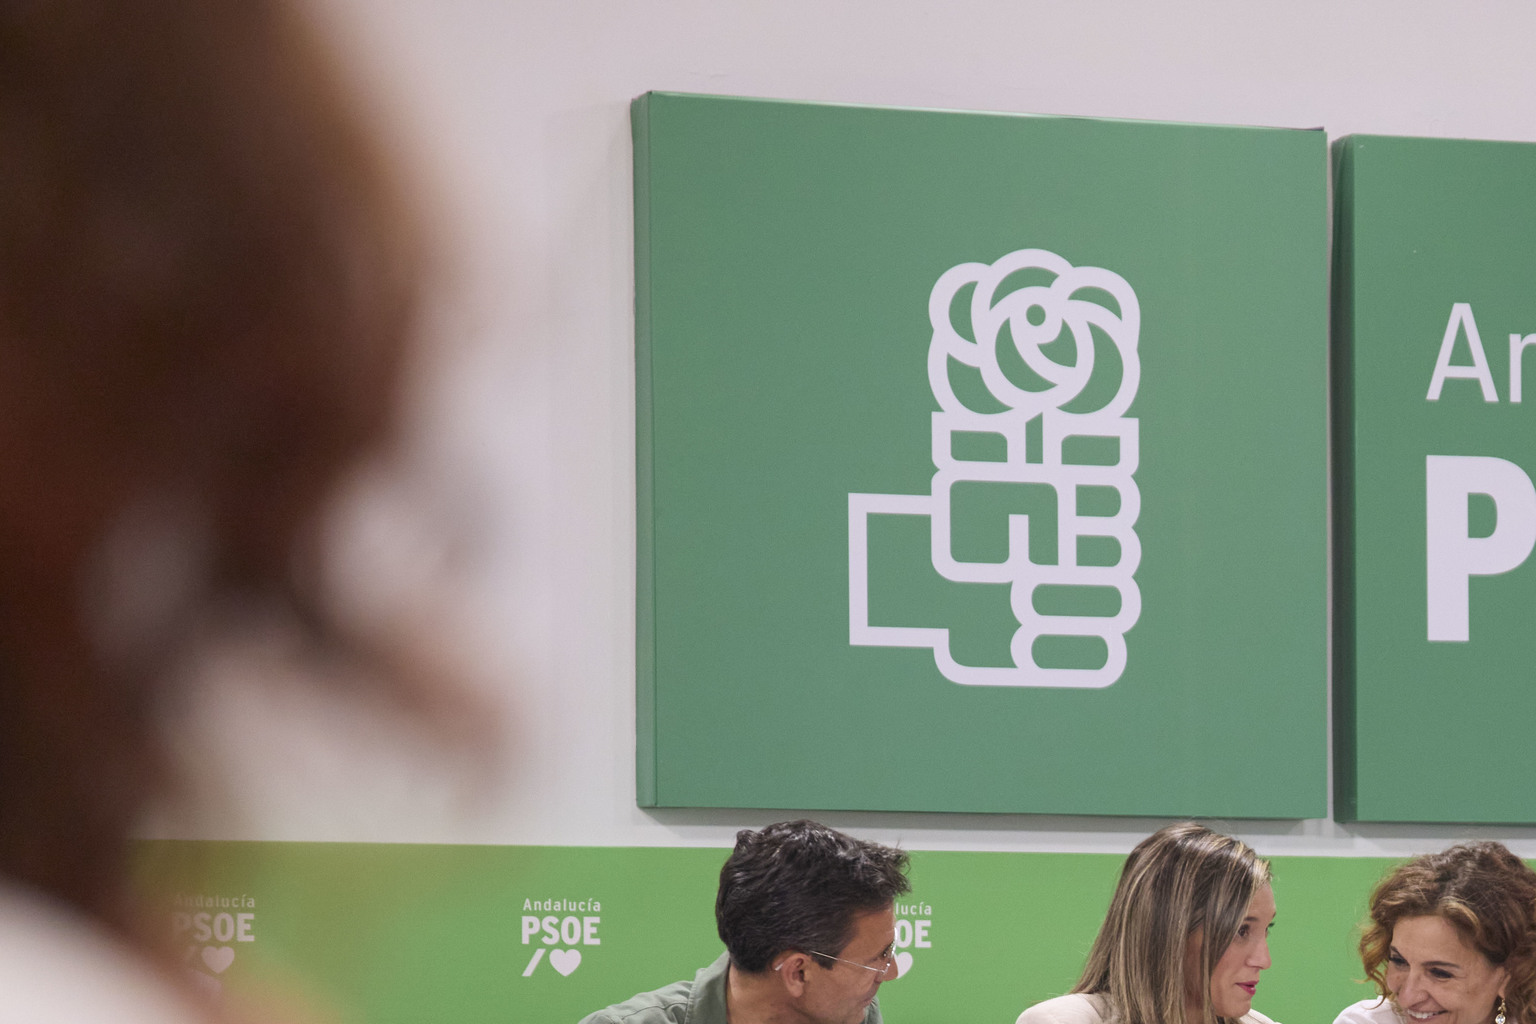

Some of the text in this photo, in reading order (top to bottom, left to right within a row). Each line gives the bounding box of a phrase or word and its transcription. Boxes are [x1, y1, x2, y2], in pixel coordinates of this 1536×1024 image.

[523, 897, 601, 912] Andalucía
[895, 902, 932, 915] lucía
[521, 915, 601, 946] PSOE
[896, 919, 932, 949] OE
